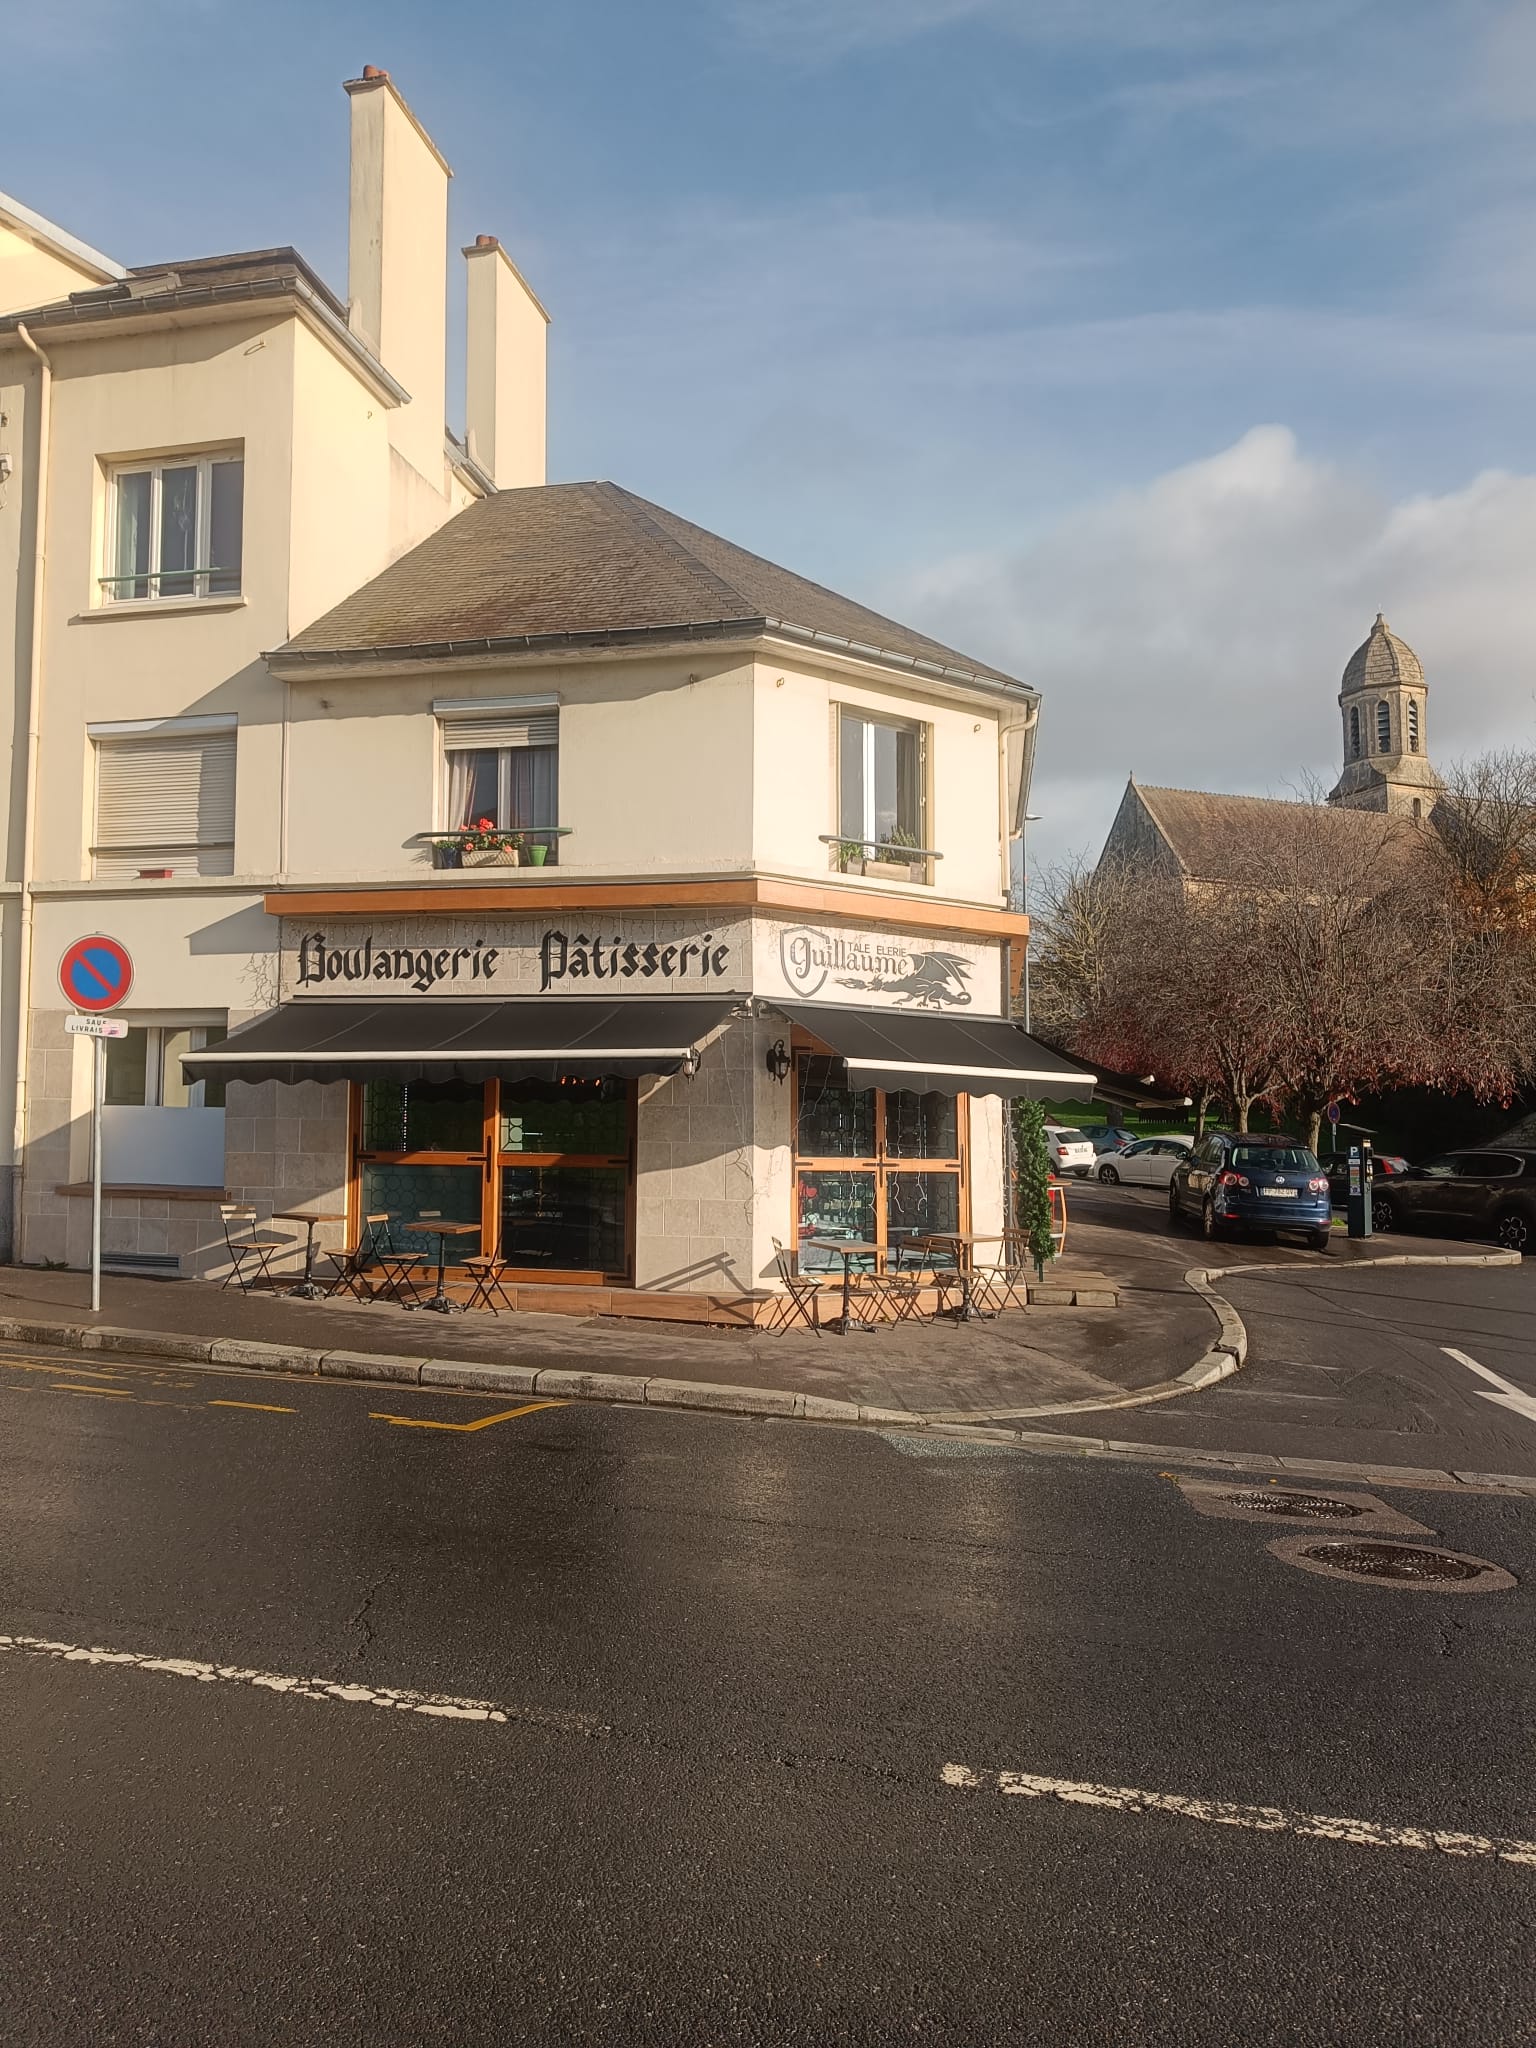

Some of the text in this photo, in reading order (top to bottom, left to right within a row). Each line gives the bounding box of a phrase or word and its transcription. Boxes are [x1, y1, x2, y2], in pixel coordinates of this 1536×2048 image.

[296, 929, 730, 992] Boulangerie Pâtisserie
[790, 937, 908, 979] Guillaume
[847, 942, 871, 953] TALE
[1350, 1146, 1359, 1157] P
